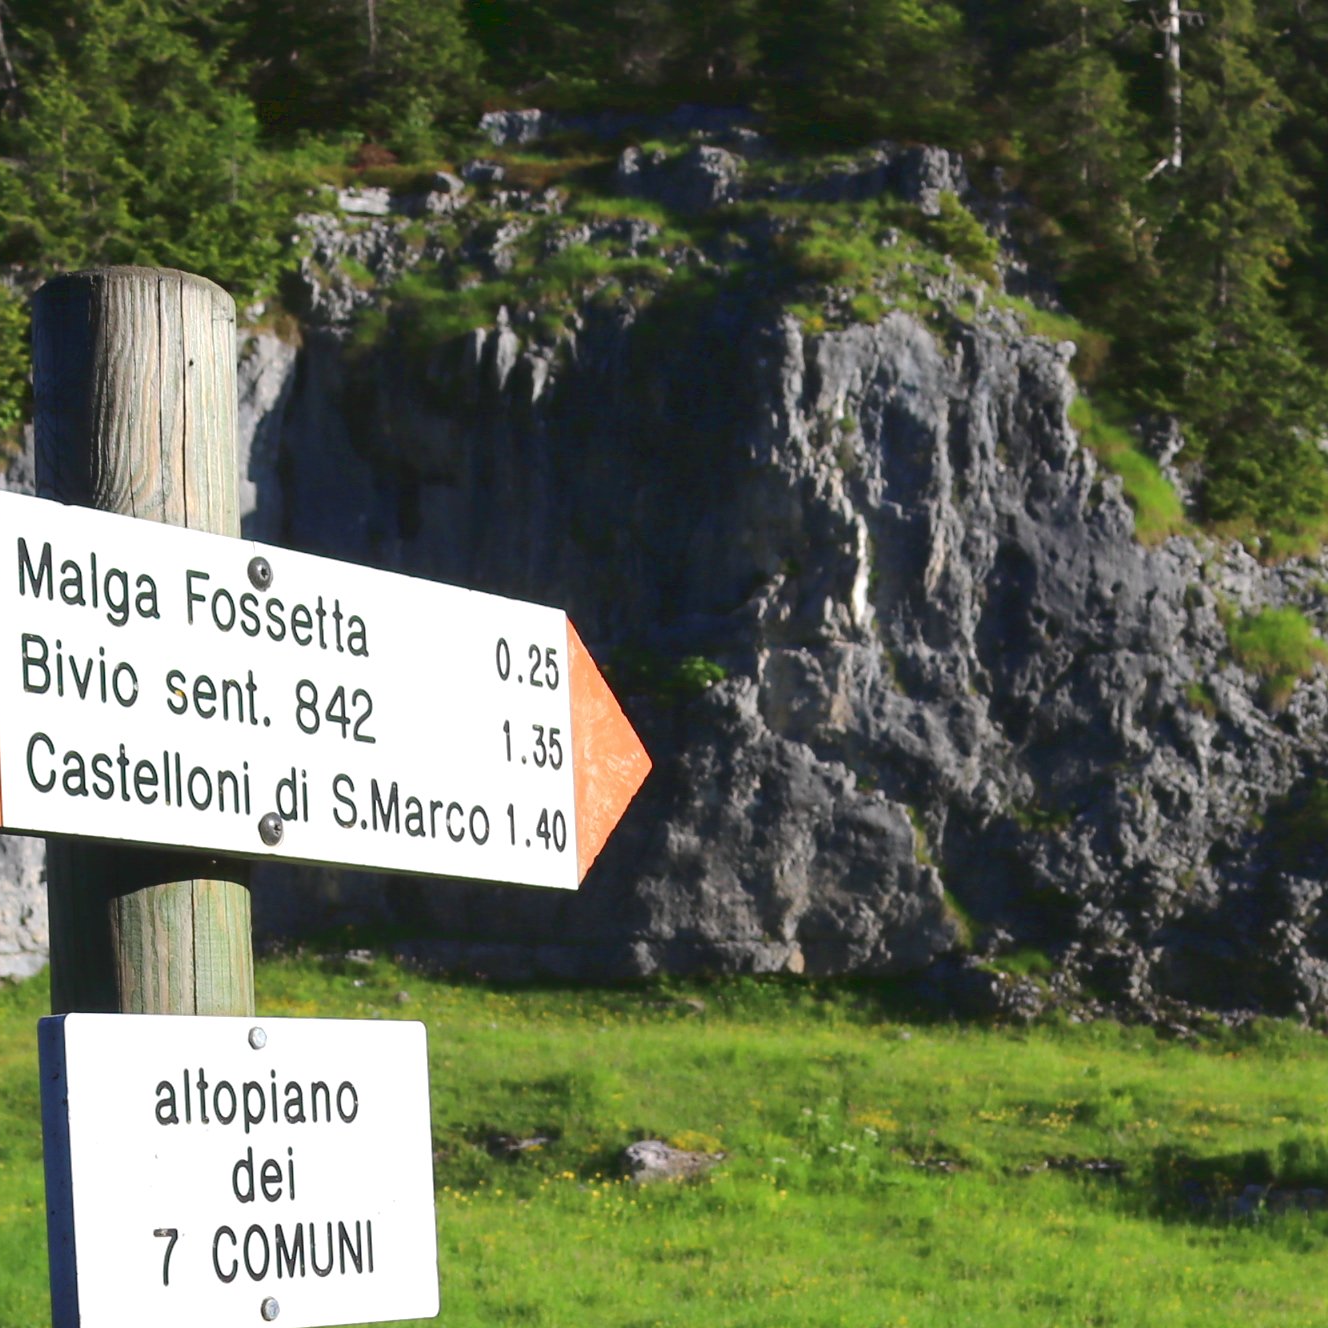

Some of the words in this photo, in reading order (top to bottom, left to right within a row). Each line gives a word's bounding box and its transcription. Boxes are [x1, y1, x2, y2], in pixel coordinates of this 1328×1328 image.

[16, 536, 162, 628] Malga
[184, 569, 370, 658] Fossetta
[495, 637, 560, 691] 0.25
[21, 632, 139, 709] Bivio
[165, 669, 272, 728] sent.
[294, 679, 377, 745] 842
[503, 719, 564, 771] 1.35
[25, 732, 252, 816] Castelloni
[274, 767, 310, 822] di
[331, 773, 491, 847] S.Marco
[506, 803, 568, 853] 1.40
[154, 1067, 360, 1134] altopiano
[231, 1145, 296, 1204] dei
[153, 1228, 179, 1287] 7
[212, 1219, 375, 1284] COMUNI
